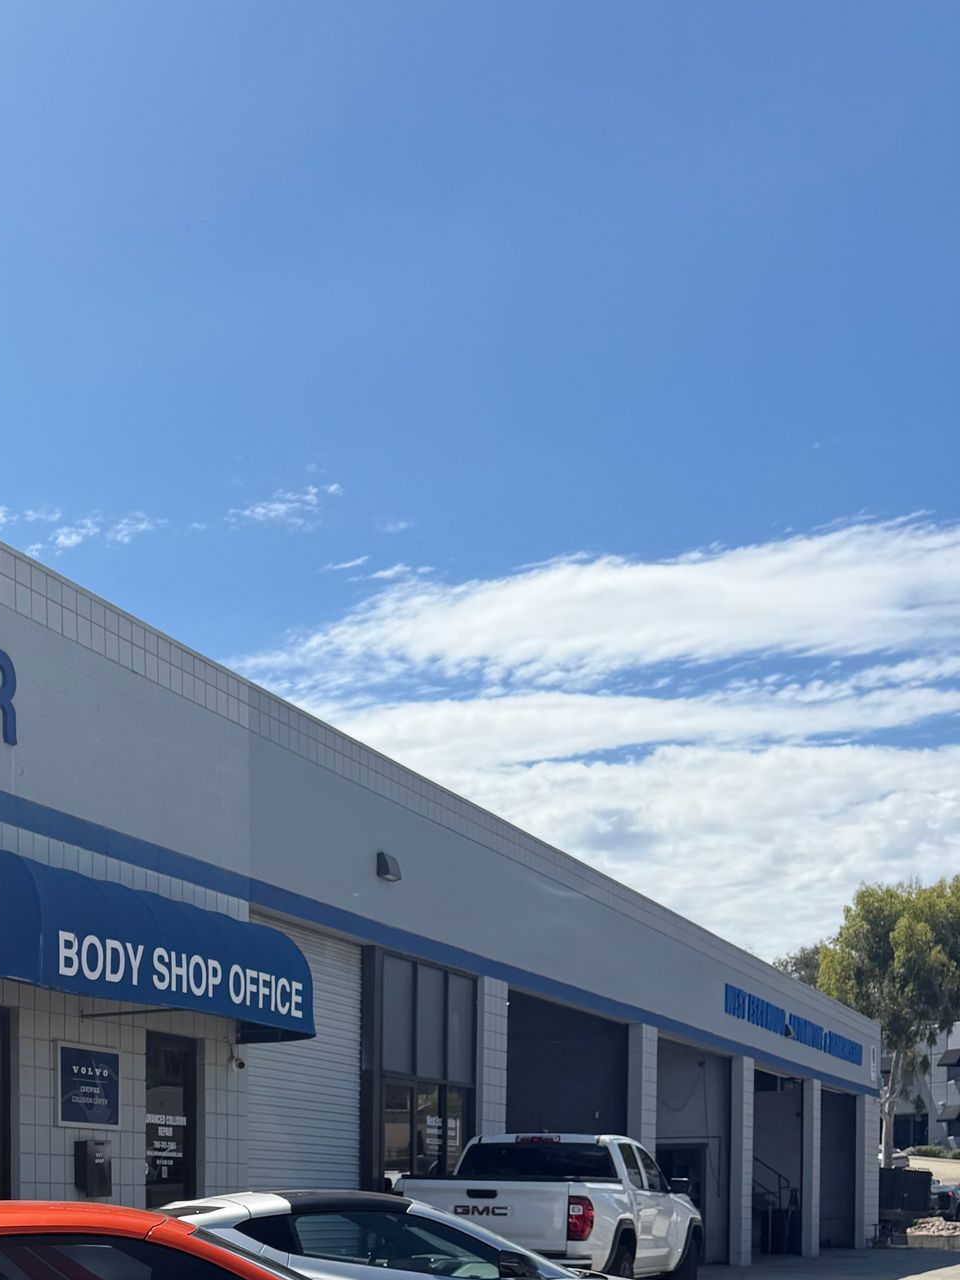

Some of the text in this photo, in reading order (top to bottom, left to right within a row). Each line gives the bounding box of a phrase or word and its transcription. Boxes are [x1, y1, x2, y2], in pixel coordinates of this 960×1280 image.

[58, 930, 303, 1018] BODY SHOP OFFICE
[72, 1065, 109, 1077] VOLVO
[454, 1205, 509, 1216] GMC
